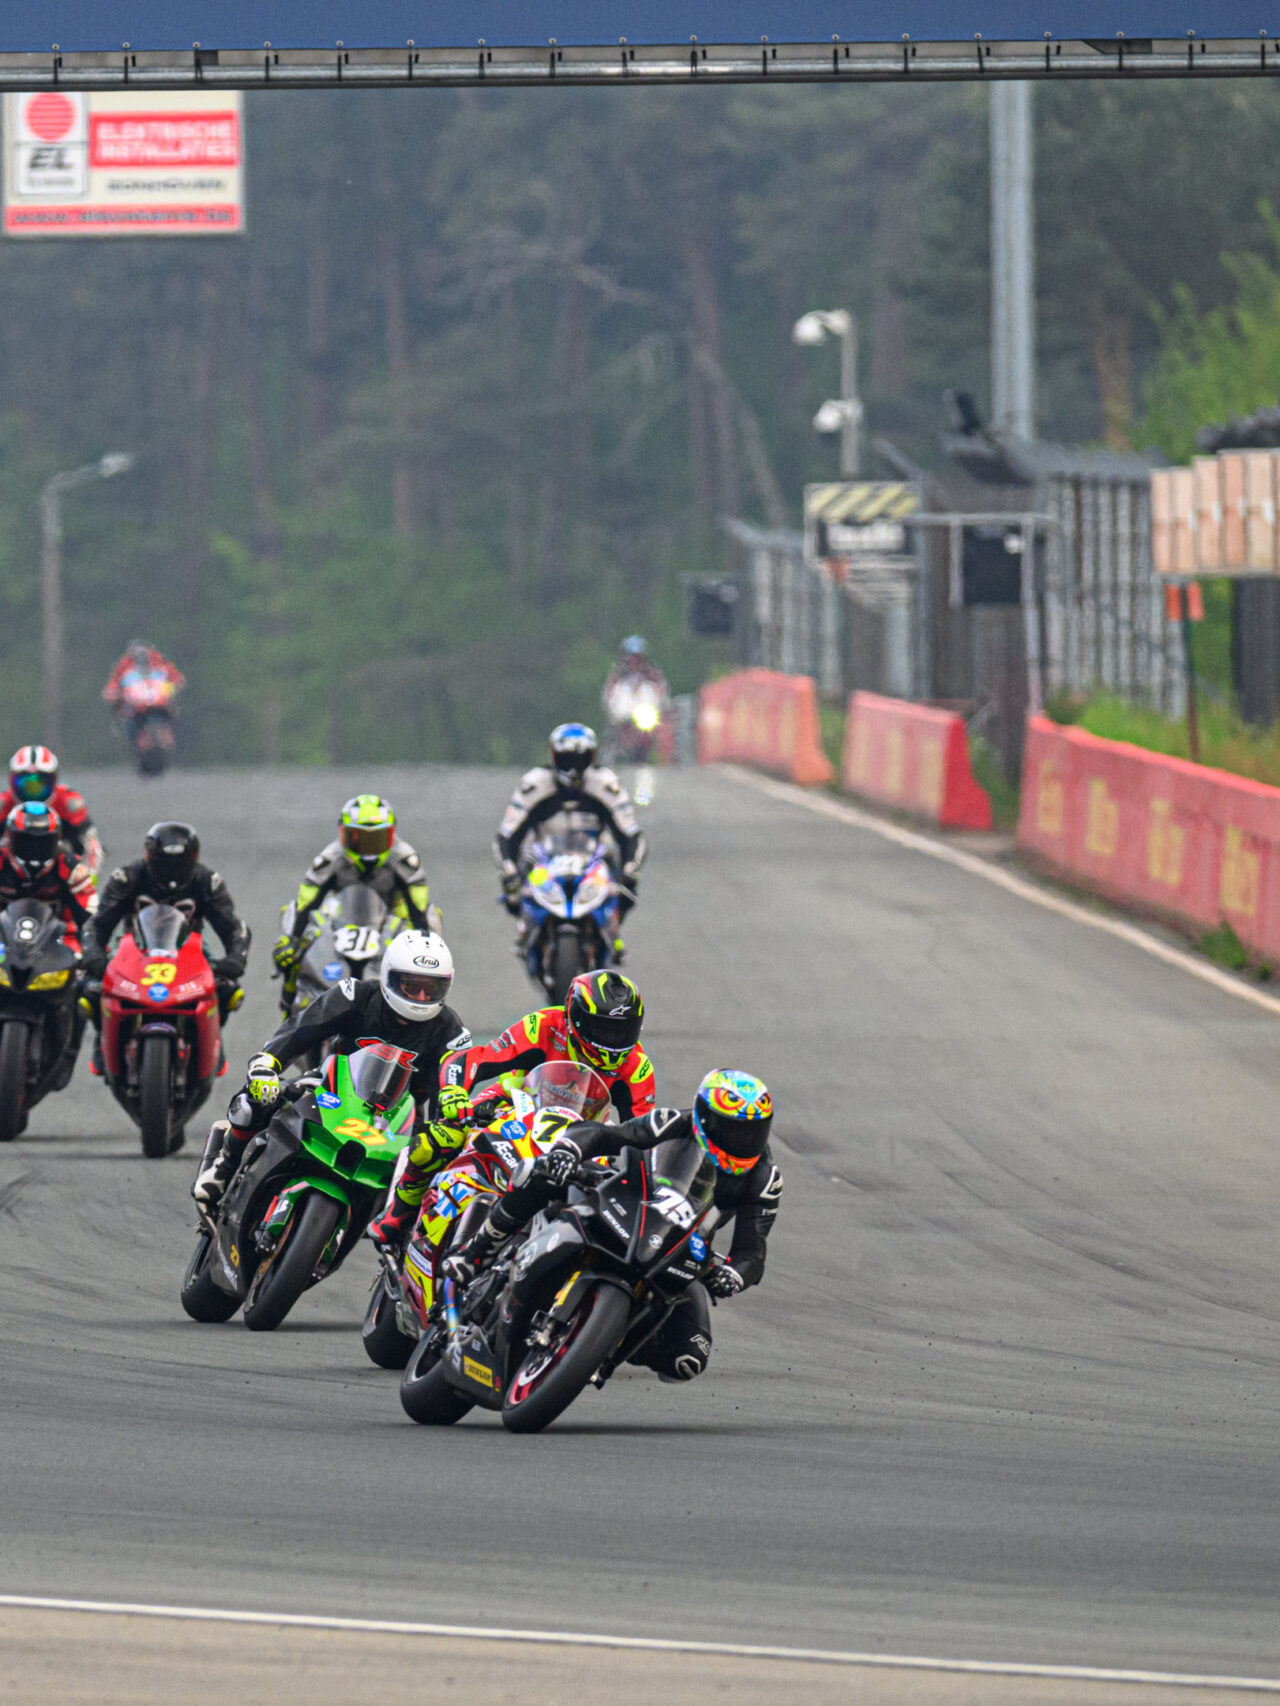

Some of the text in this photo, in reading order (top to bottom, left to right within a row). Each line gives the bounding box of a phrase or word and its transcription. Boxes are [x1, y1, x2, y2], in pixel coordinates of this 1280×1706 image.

[333, 1117, 388, 1146] 27
[651, 1186, 697, 1230] 75
[602, 1209, 631, 1239] DUNLOP
[666, 1266, 695, 1280] DUNLOP
